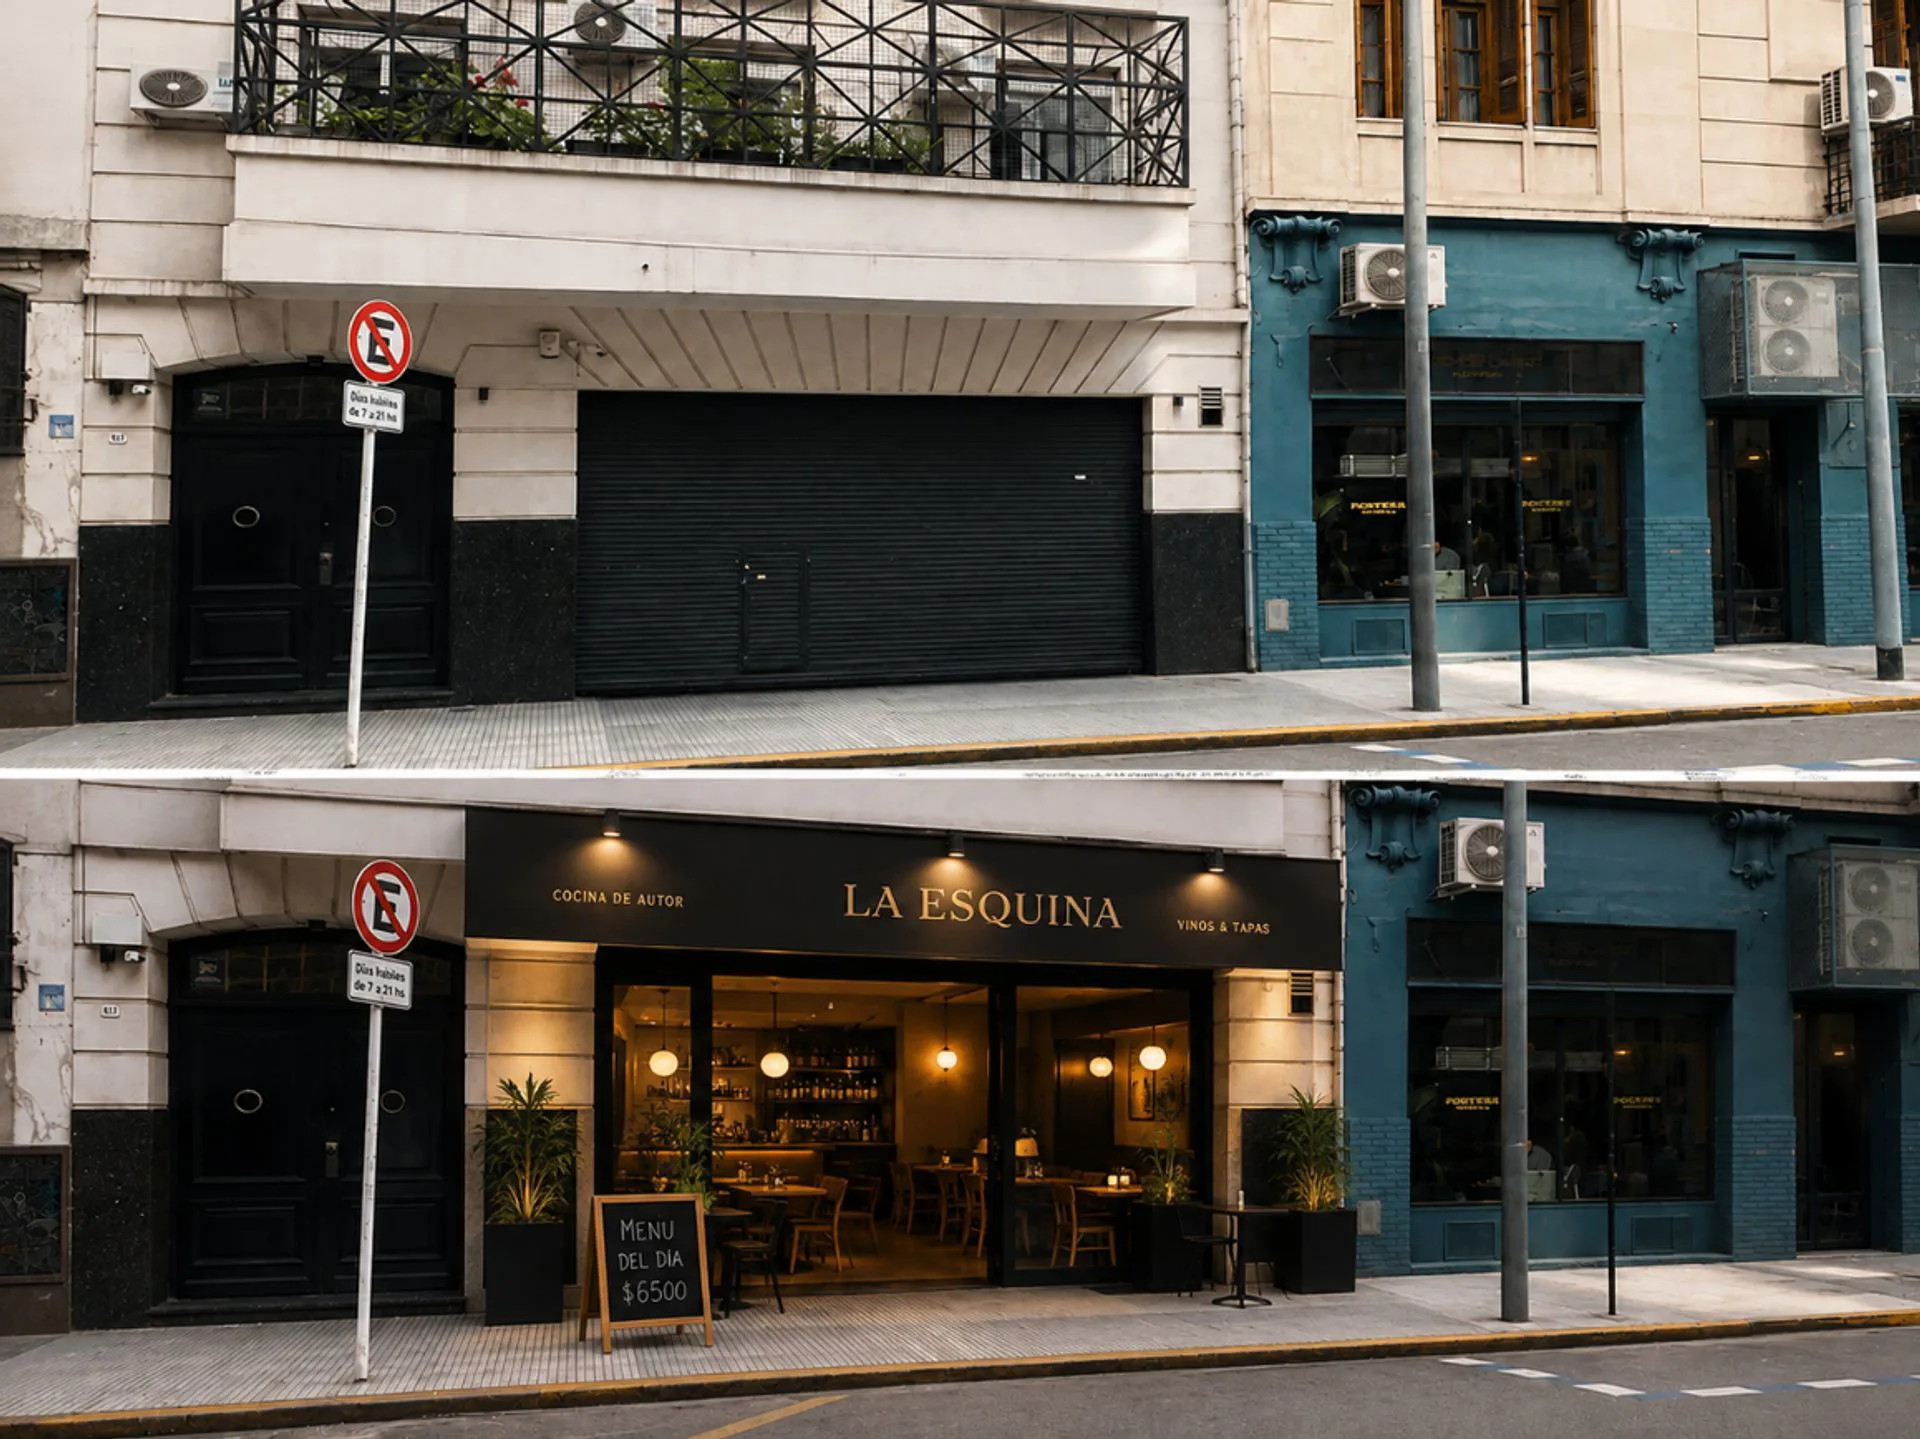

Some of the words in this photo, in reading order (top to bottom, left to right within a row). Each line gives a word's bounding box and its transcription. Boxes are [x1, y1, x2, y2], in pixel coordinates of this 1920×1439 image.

[552, 888, 607, 904] COCINA
[613, 892, 631, 905] DE
[637, 893, 684, 908] AUTOR
[844, 884, 903, 918] LA
[919, 887, 1123, 929] ESQUINA
[1177, 919, 1215, 932] VINOS
[1219, 921, 1228, 932] &
[1232, 922, 1270, 935] TAPAS
[382, 984, 393, 996] 21
[620, 1218, 675, 1241] MENU
[618, 1252, 649, 1272] DEL
[622, 1280, 687, 1307] $6500
